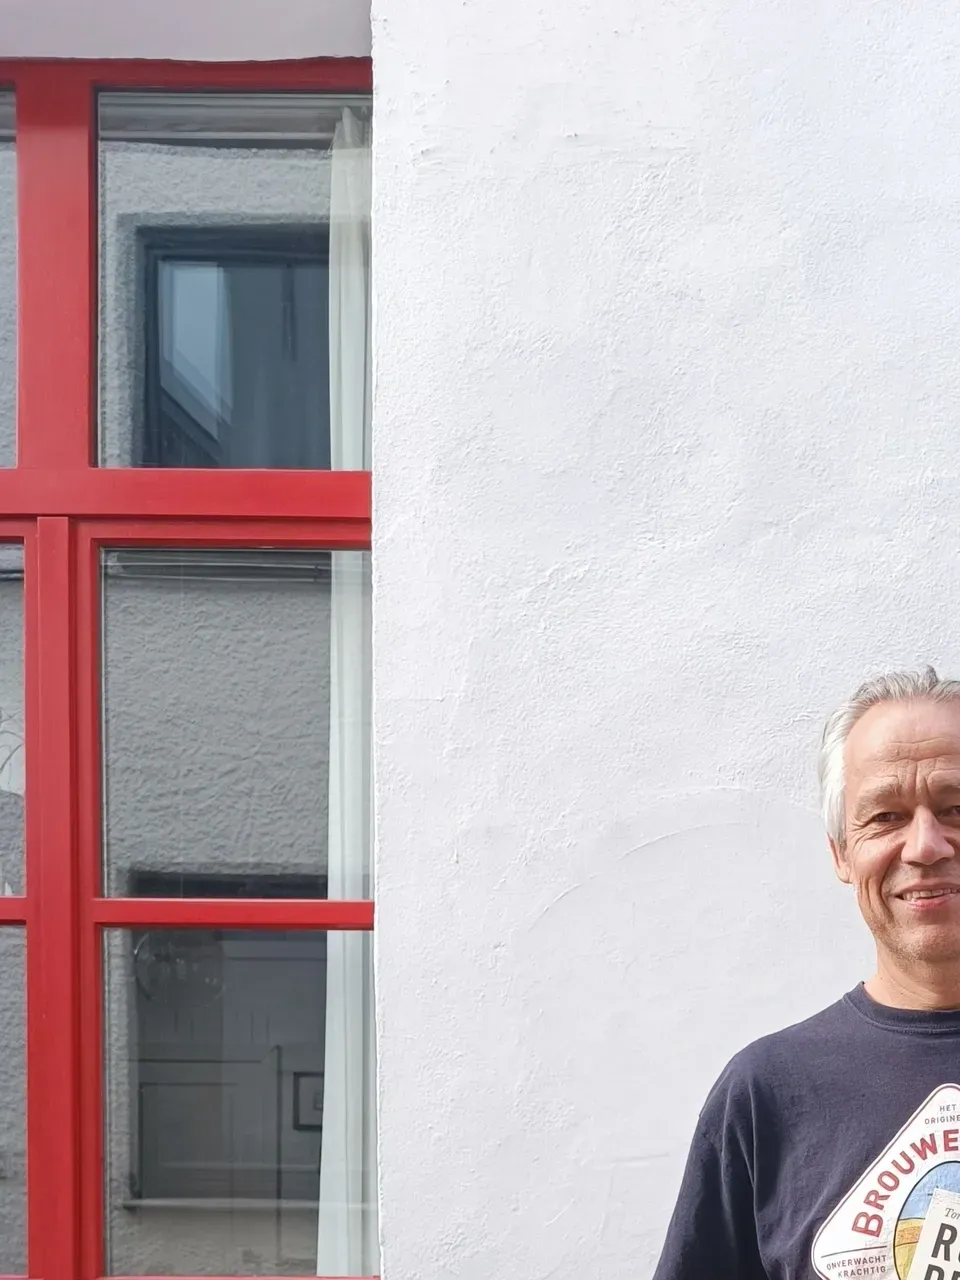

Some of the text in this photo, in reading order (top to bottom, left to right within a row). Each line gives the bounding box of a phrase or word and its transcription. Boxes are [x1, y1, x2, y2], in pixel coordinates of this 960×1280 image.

[939, 1104, 957, 1113] HET
[826, 1255, 887, 1271] ONVERWACHT
[837, 1266, 886, 1279] KRACHTIG
